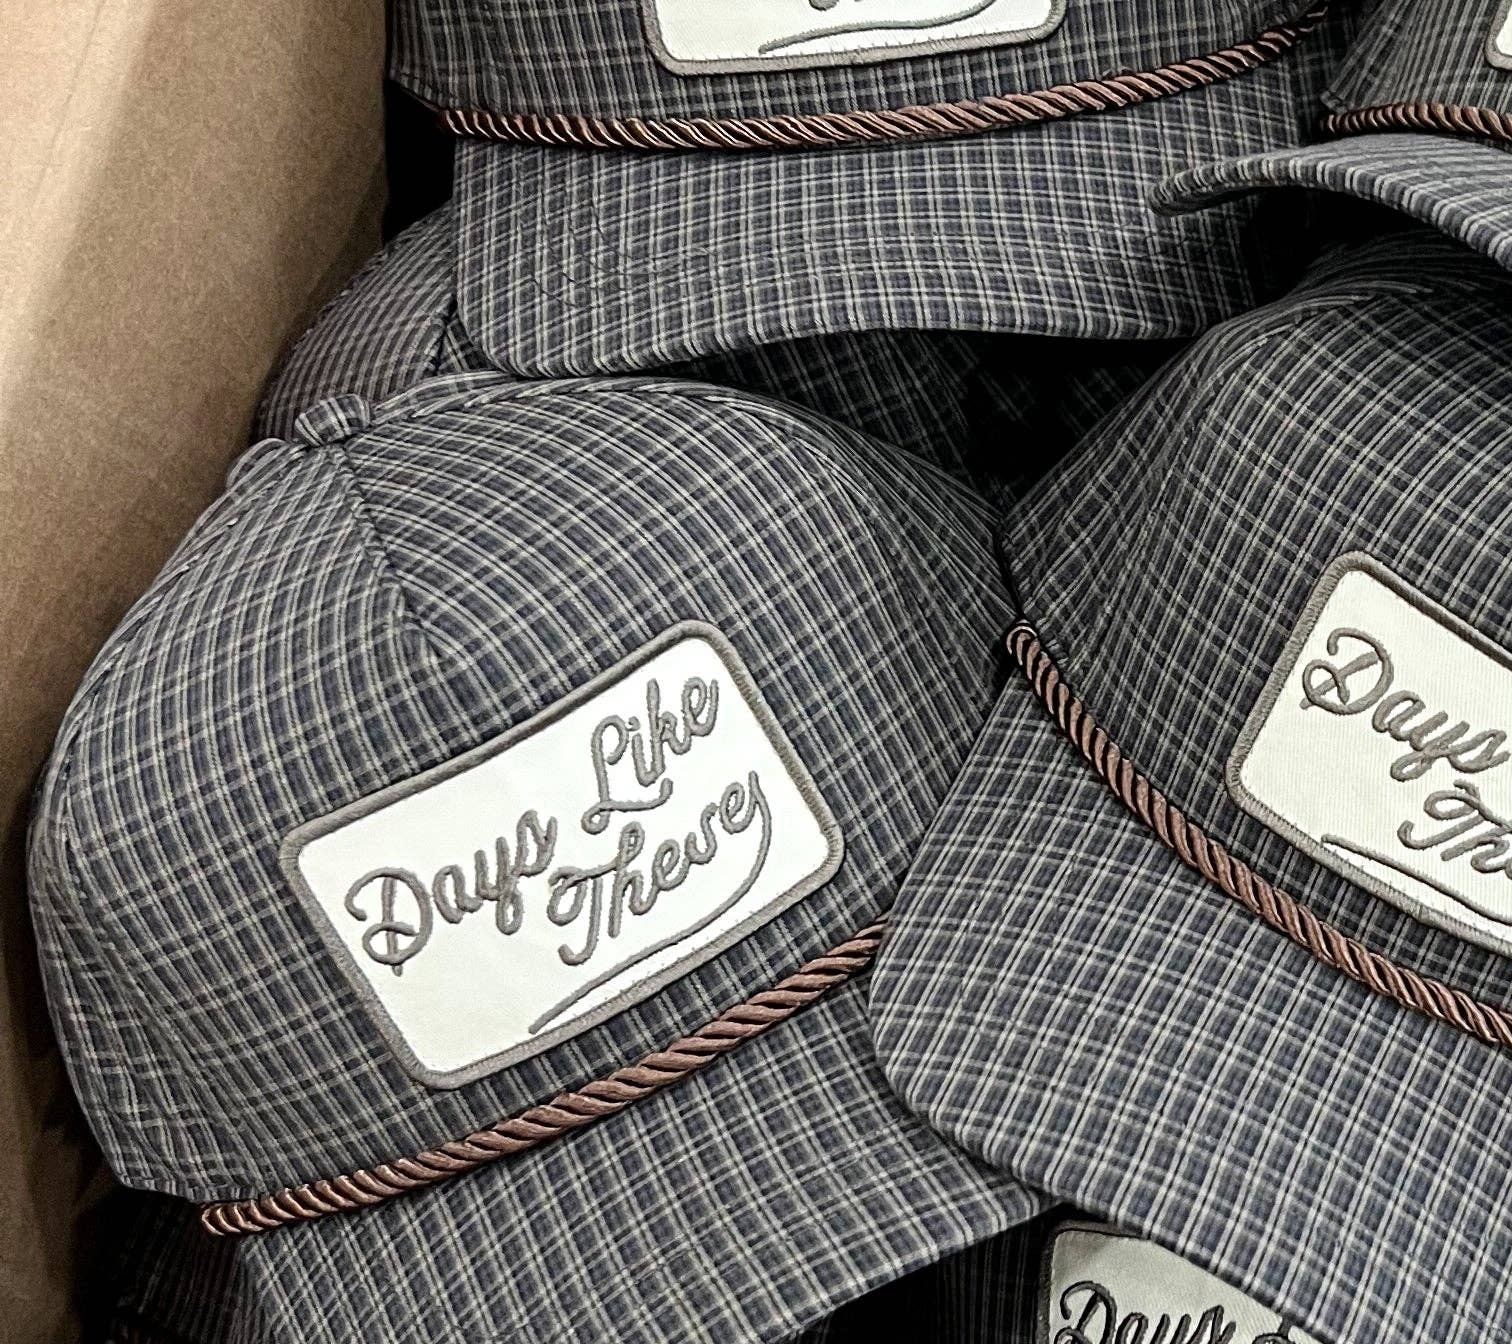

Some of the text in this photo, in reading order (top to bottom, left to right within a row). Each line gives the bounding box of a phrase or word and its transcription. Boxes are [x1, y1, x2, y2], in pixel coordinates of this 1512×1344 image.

[345, 677, 719, 977] Days Like
[1299, 627, 1511, 782] Days
[528, 770, 772, 1034] These
